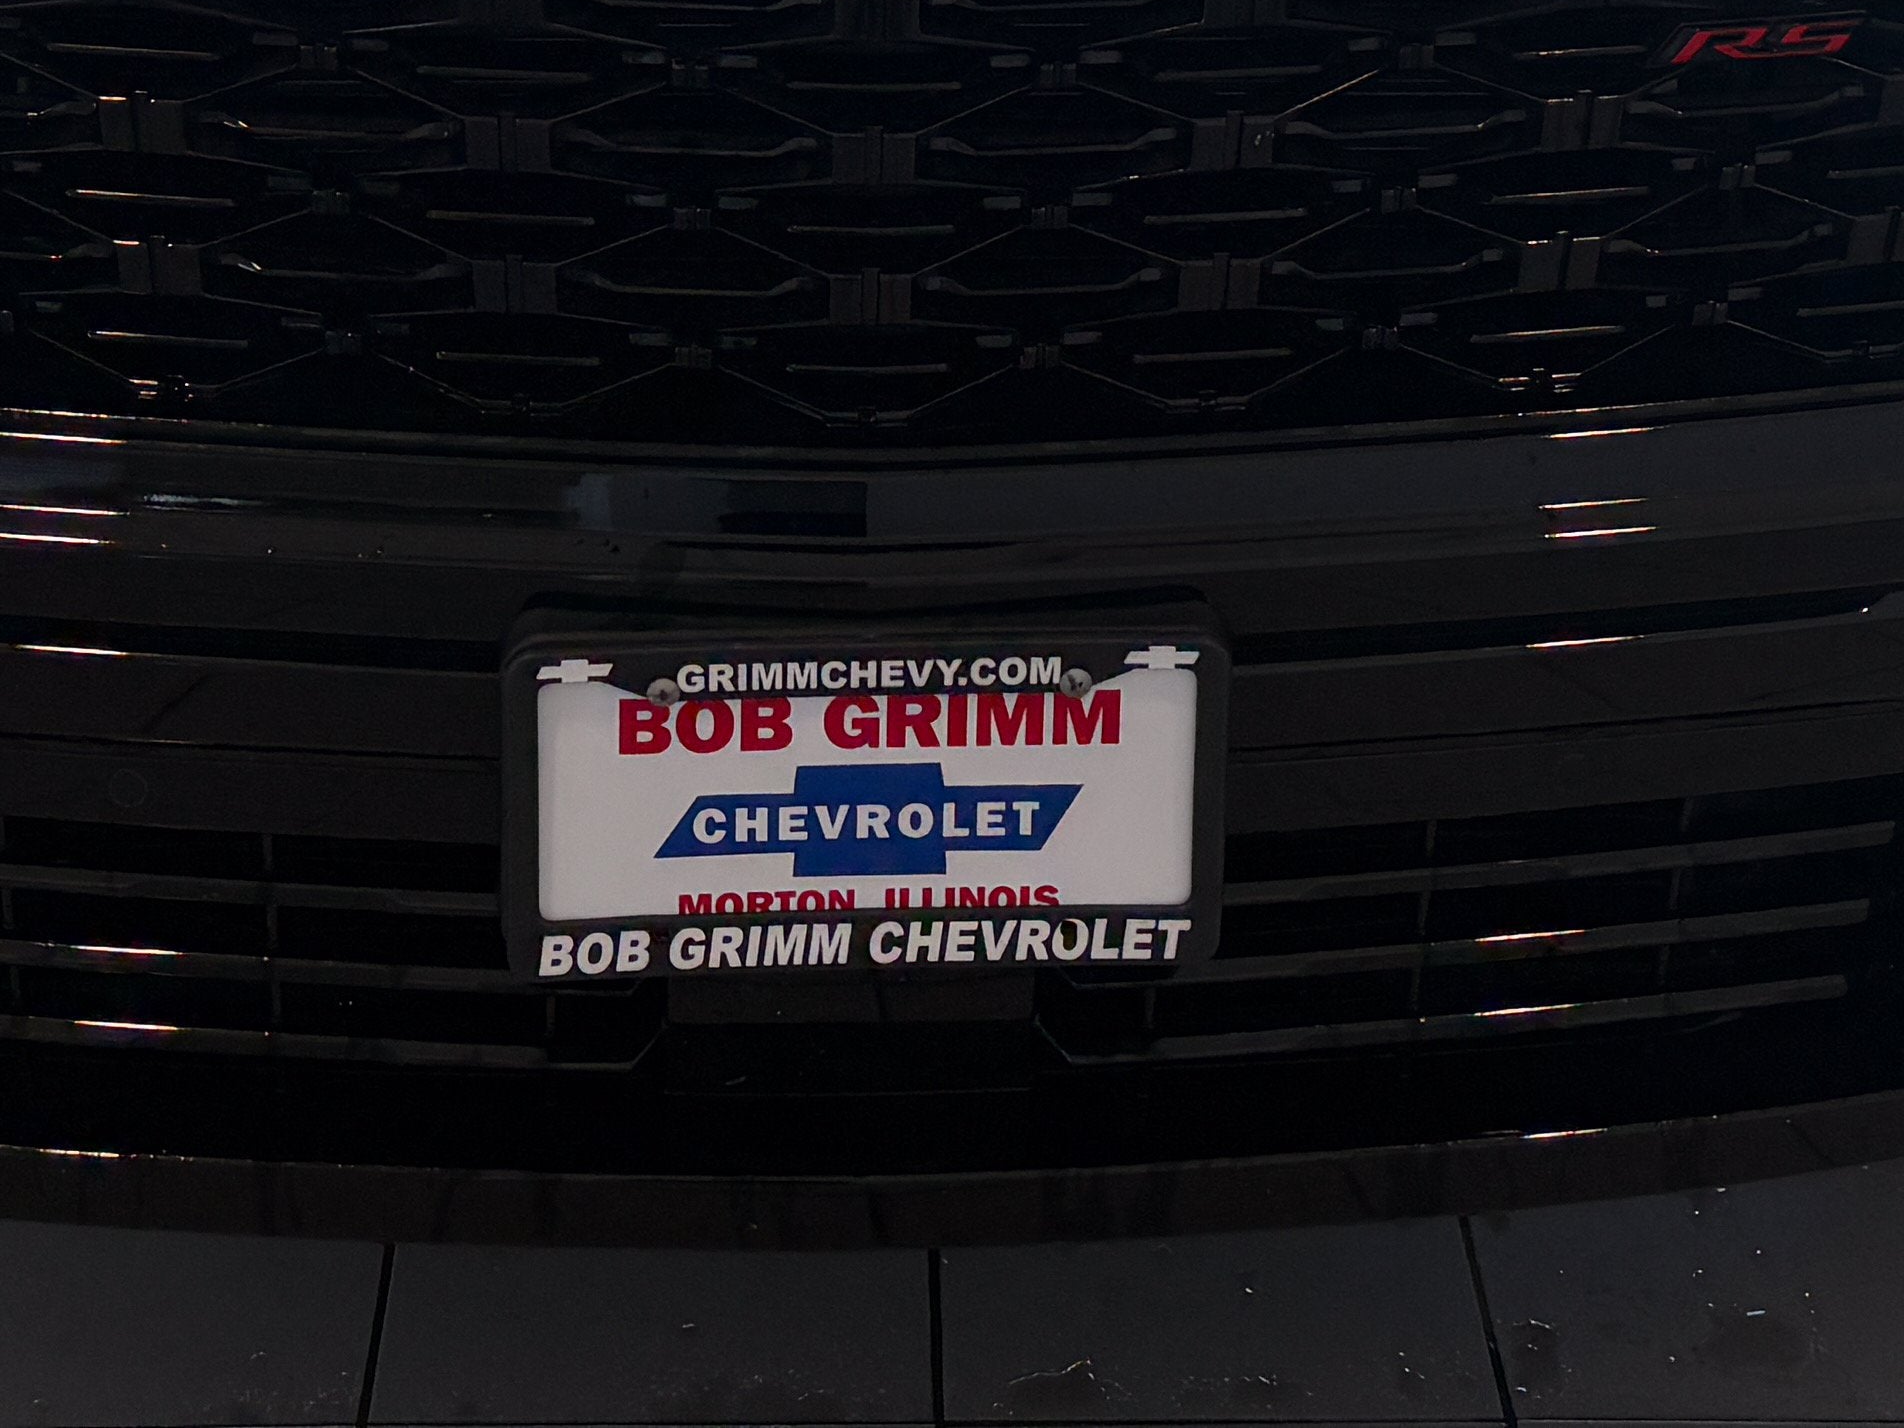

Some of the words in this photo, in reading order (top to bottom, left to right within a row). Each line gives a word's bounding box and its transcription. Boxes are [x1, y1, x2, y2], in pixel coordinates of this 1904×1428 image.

[1670, 18, 1865, 64] RS
[676, 656, 1062, 693] GRIMMCHEVY.COM
[618, 697, 794, 755] BOB
[823, 689, 1121, 749] GRIMM
[692, 801, 1040, 844] CHEVROLET
[678, 889, 856, 916] MORTON
[884, 885, 1060, 910] ILLINOIS
[538, 930, 651, 977] BOB
[668, 923, 853, 970] GRIMM
[868, 918, 1192, 964] CHEVROLET
